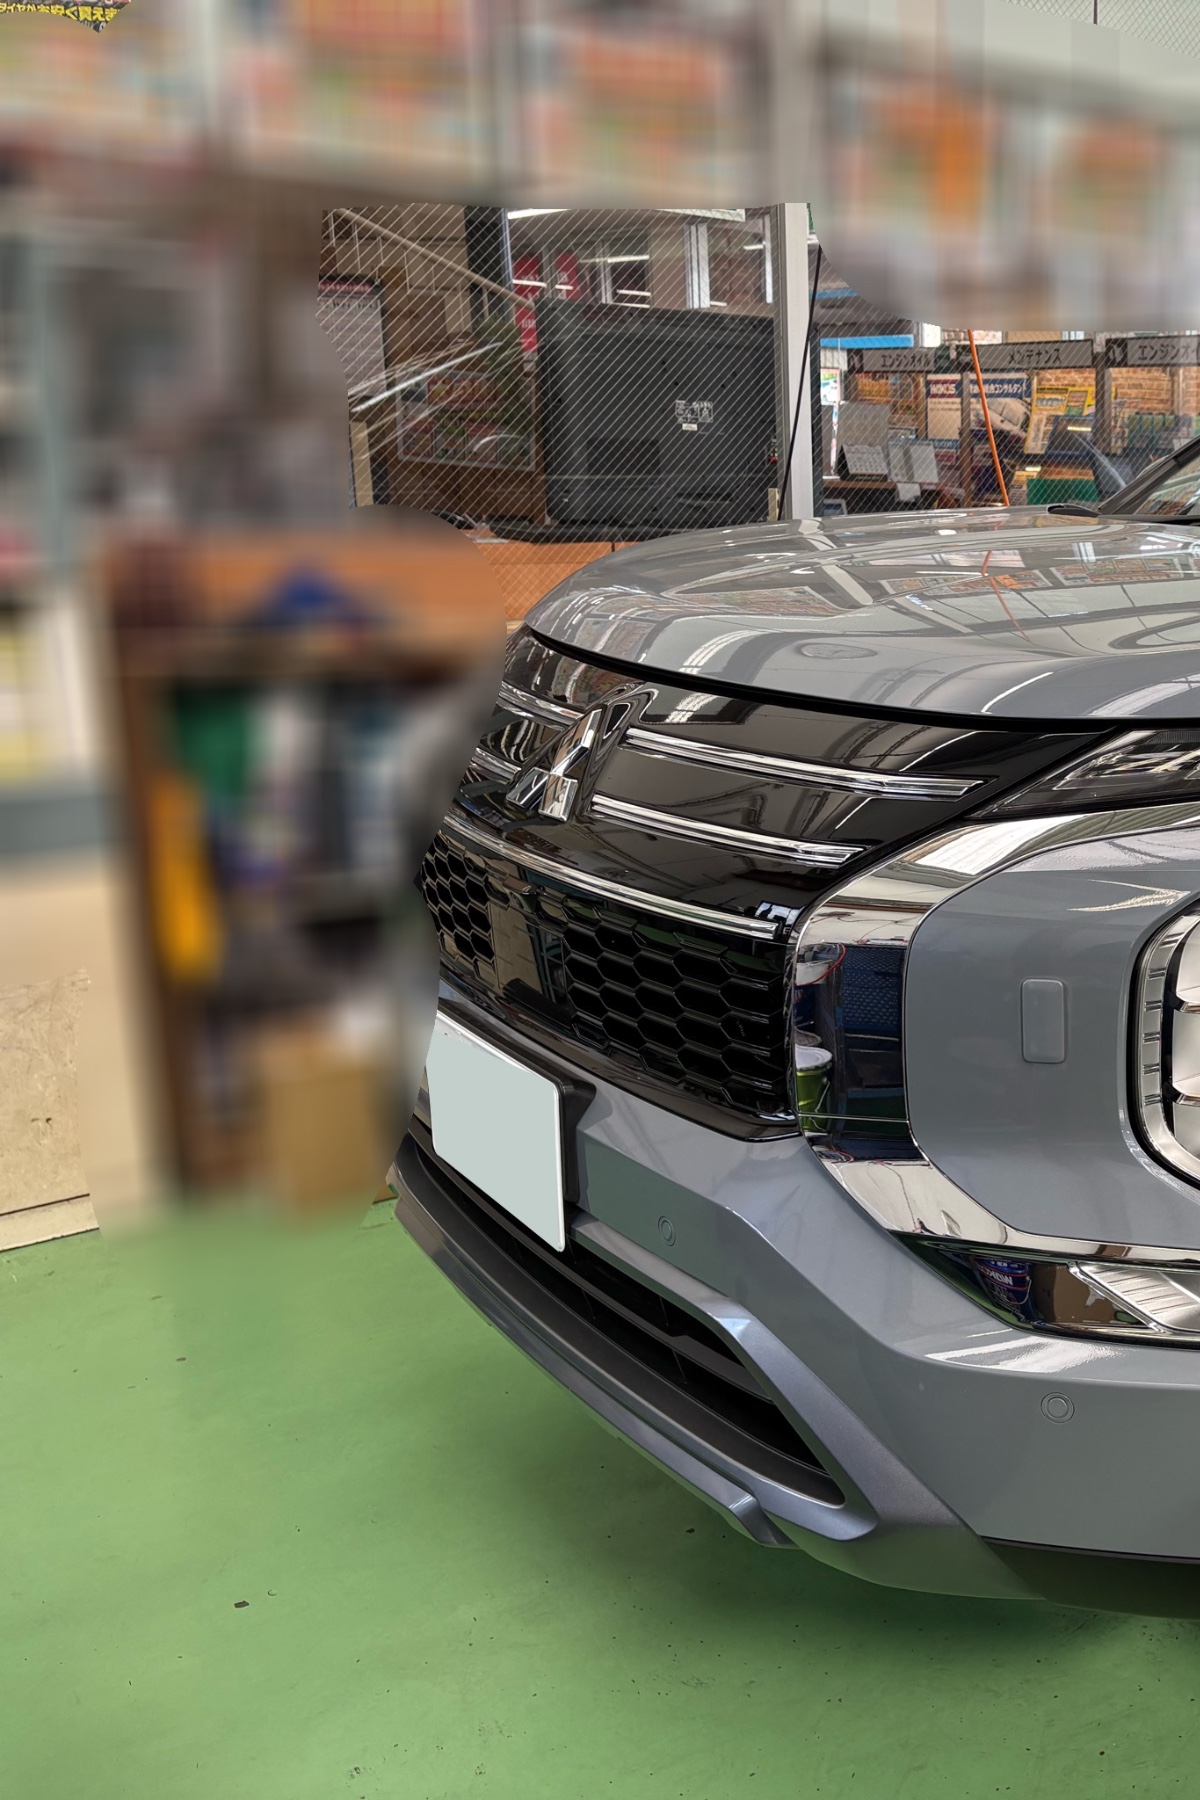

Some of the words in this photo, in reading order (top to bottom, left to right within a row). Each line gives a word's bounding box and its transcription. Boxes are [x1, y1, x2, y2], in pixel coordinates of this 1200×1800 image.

[881, 353, 932, 368] エンジンオイル
[1008, 348, 1062, 365] メンテナンス
